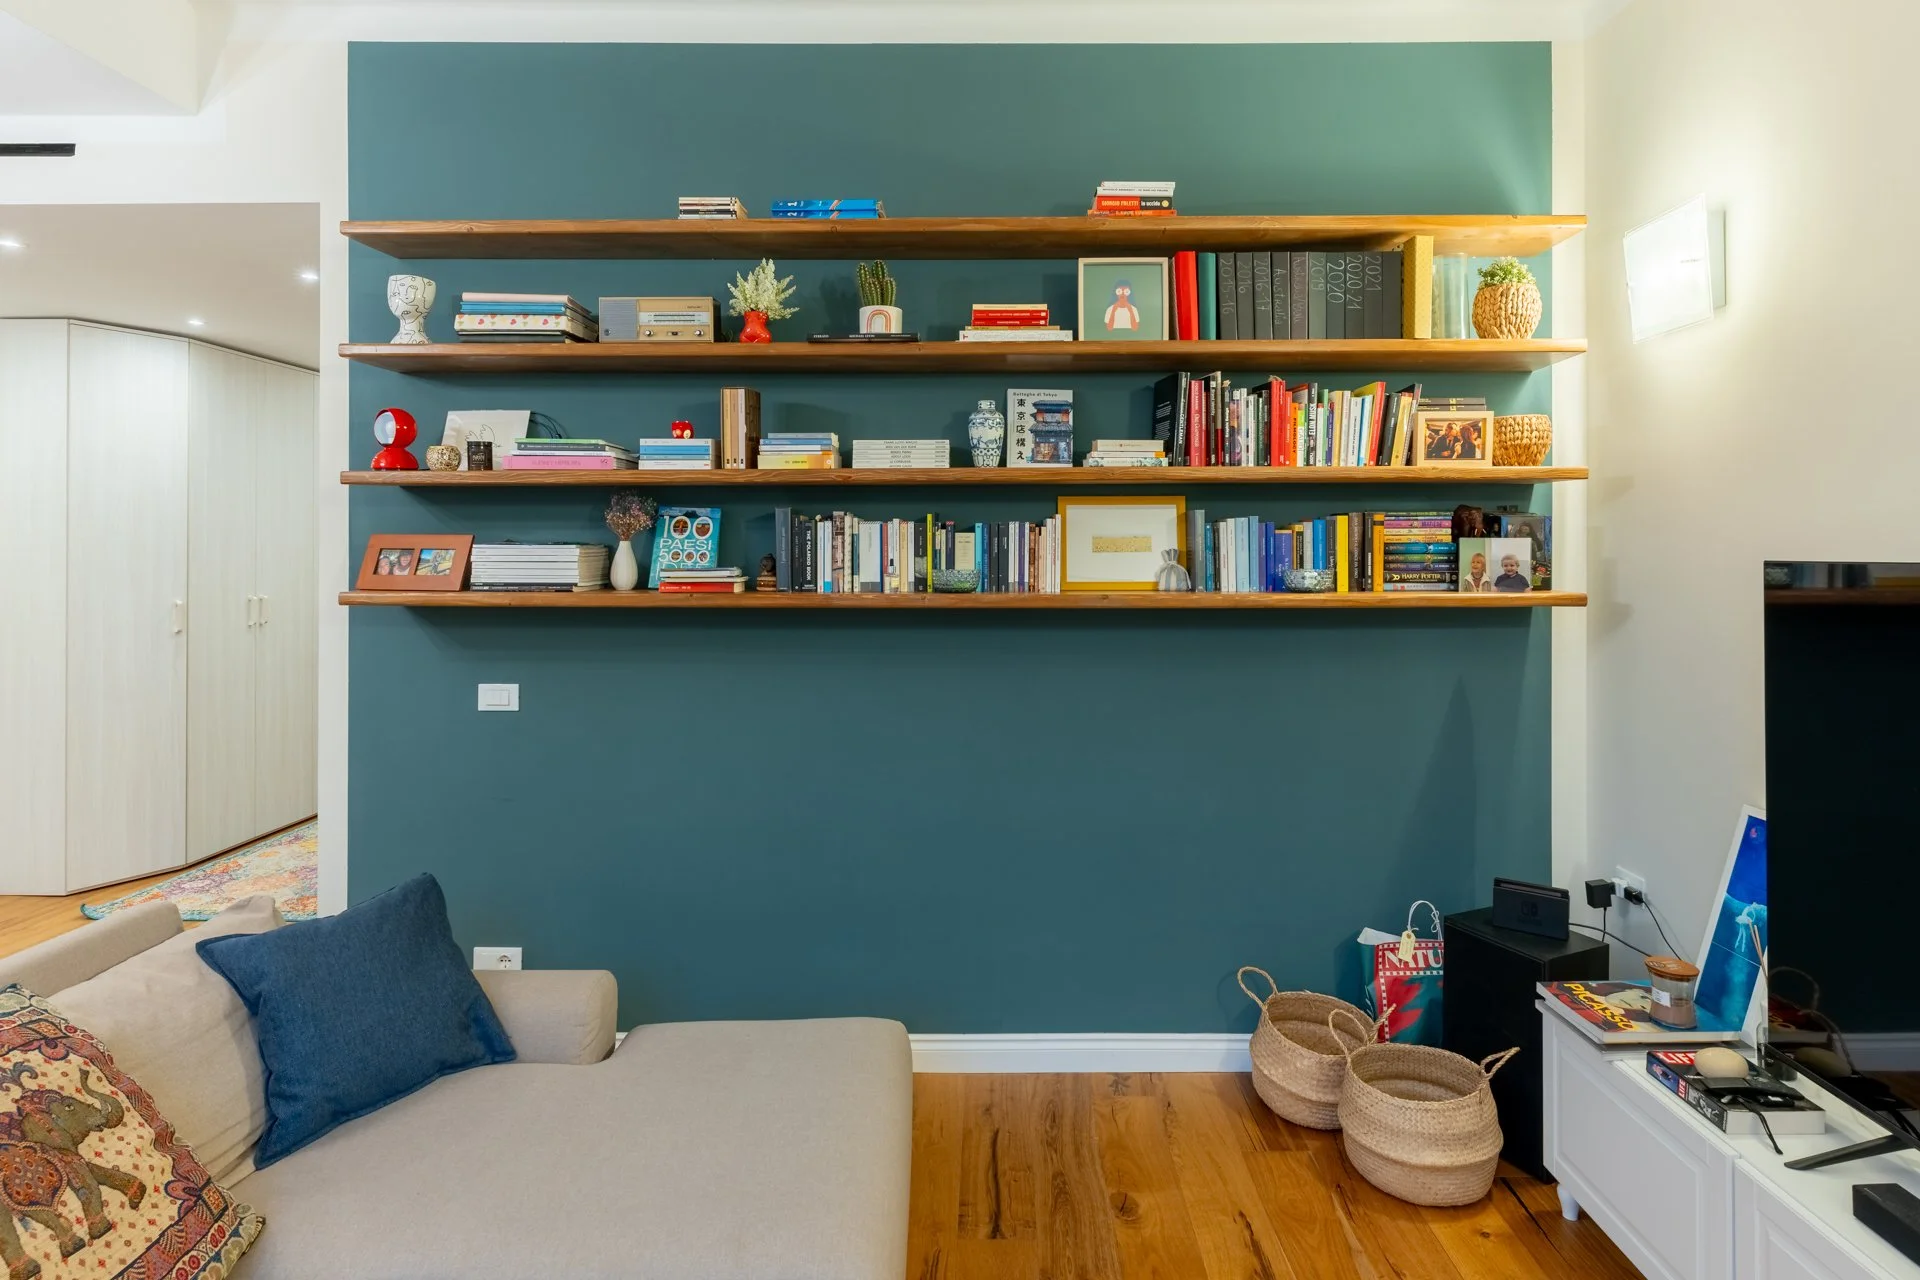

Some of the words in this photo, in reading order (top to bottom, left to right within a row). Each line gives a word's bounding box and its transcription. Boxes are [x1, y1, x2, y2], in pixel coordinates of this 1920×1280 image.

[1237, 260, 1252, 294] 2016
[1254, 258, 1271, 311] 2016-17
[1310, 256, 1325, 292] 2019
[1326, 259, 1346, 305] 2020
[1346, 253, 1363, 311] 2020-21
[1364, 255, 1382, 292] 2021
[1272, 267, 1288, 326] Australia
[1016, 398, 1026, 460] 東京店構え
[660, 538, 712, 550] PAESI
[663, 516, 714, 539] 100
[658, 549, 710, 563] 5000
[1563, 983, 1634, 1030] PICASSO
